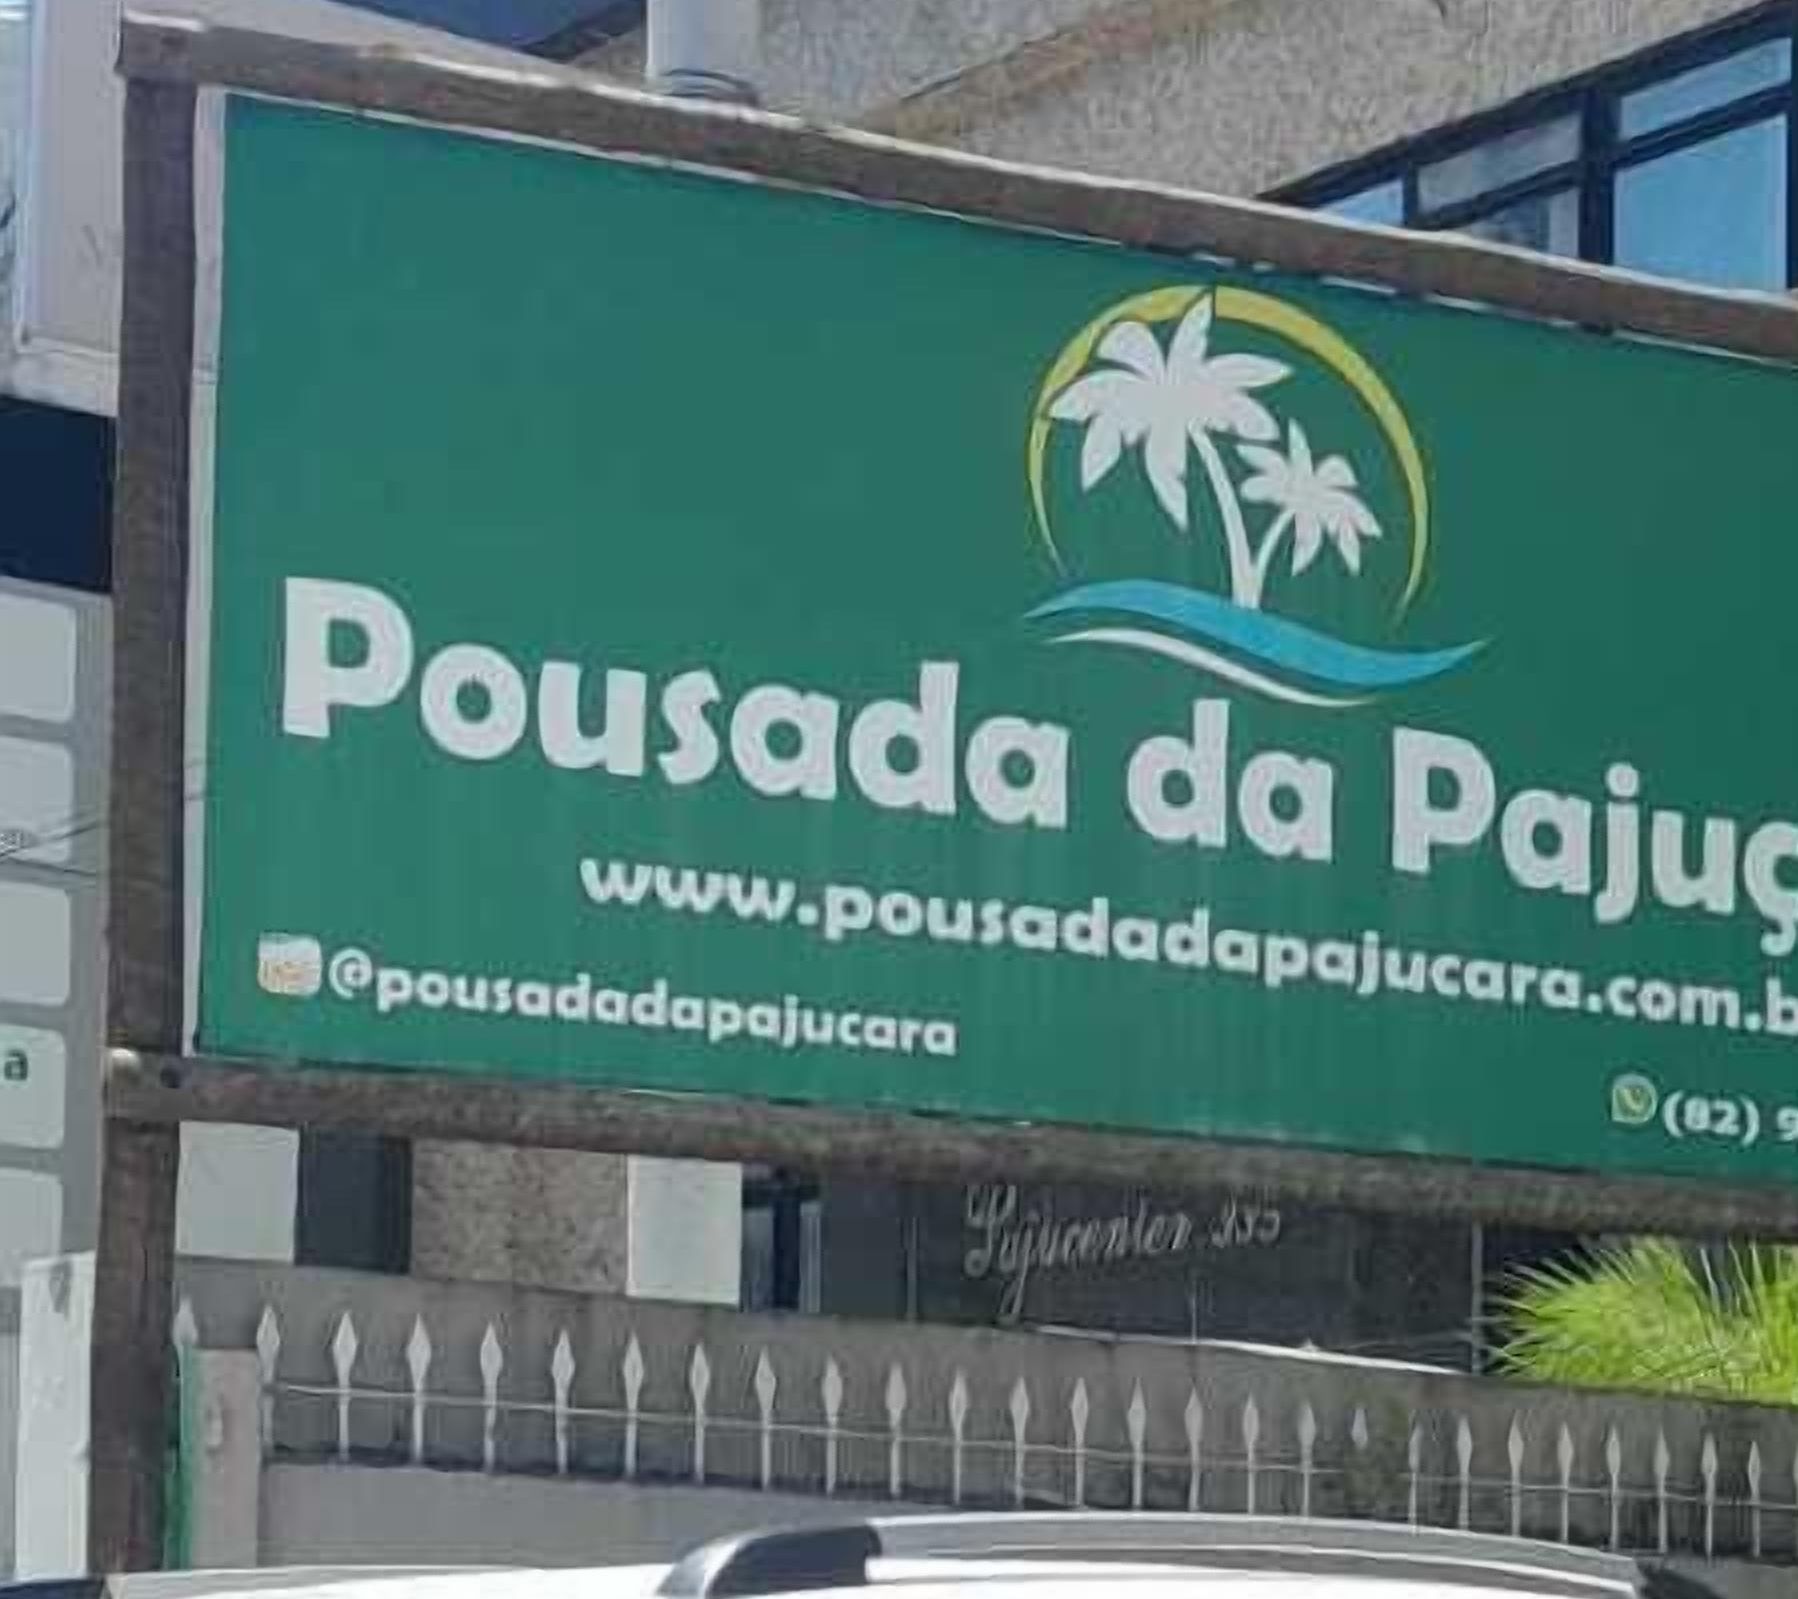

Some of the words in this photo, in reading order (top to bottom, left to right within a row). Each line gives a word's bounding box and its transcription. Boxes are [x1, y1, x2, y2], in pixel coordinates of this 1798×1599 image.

[282, 576, 1071, 831] Pousada
[1126, 696, 1336, 862] da
[328, 947, 957, 1057] @pousadadapajucara
[1662, 1091, 1761, 1146] (82)
